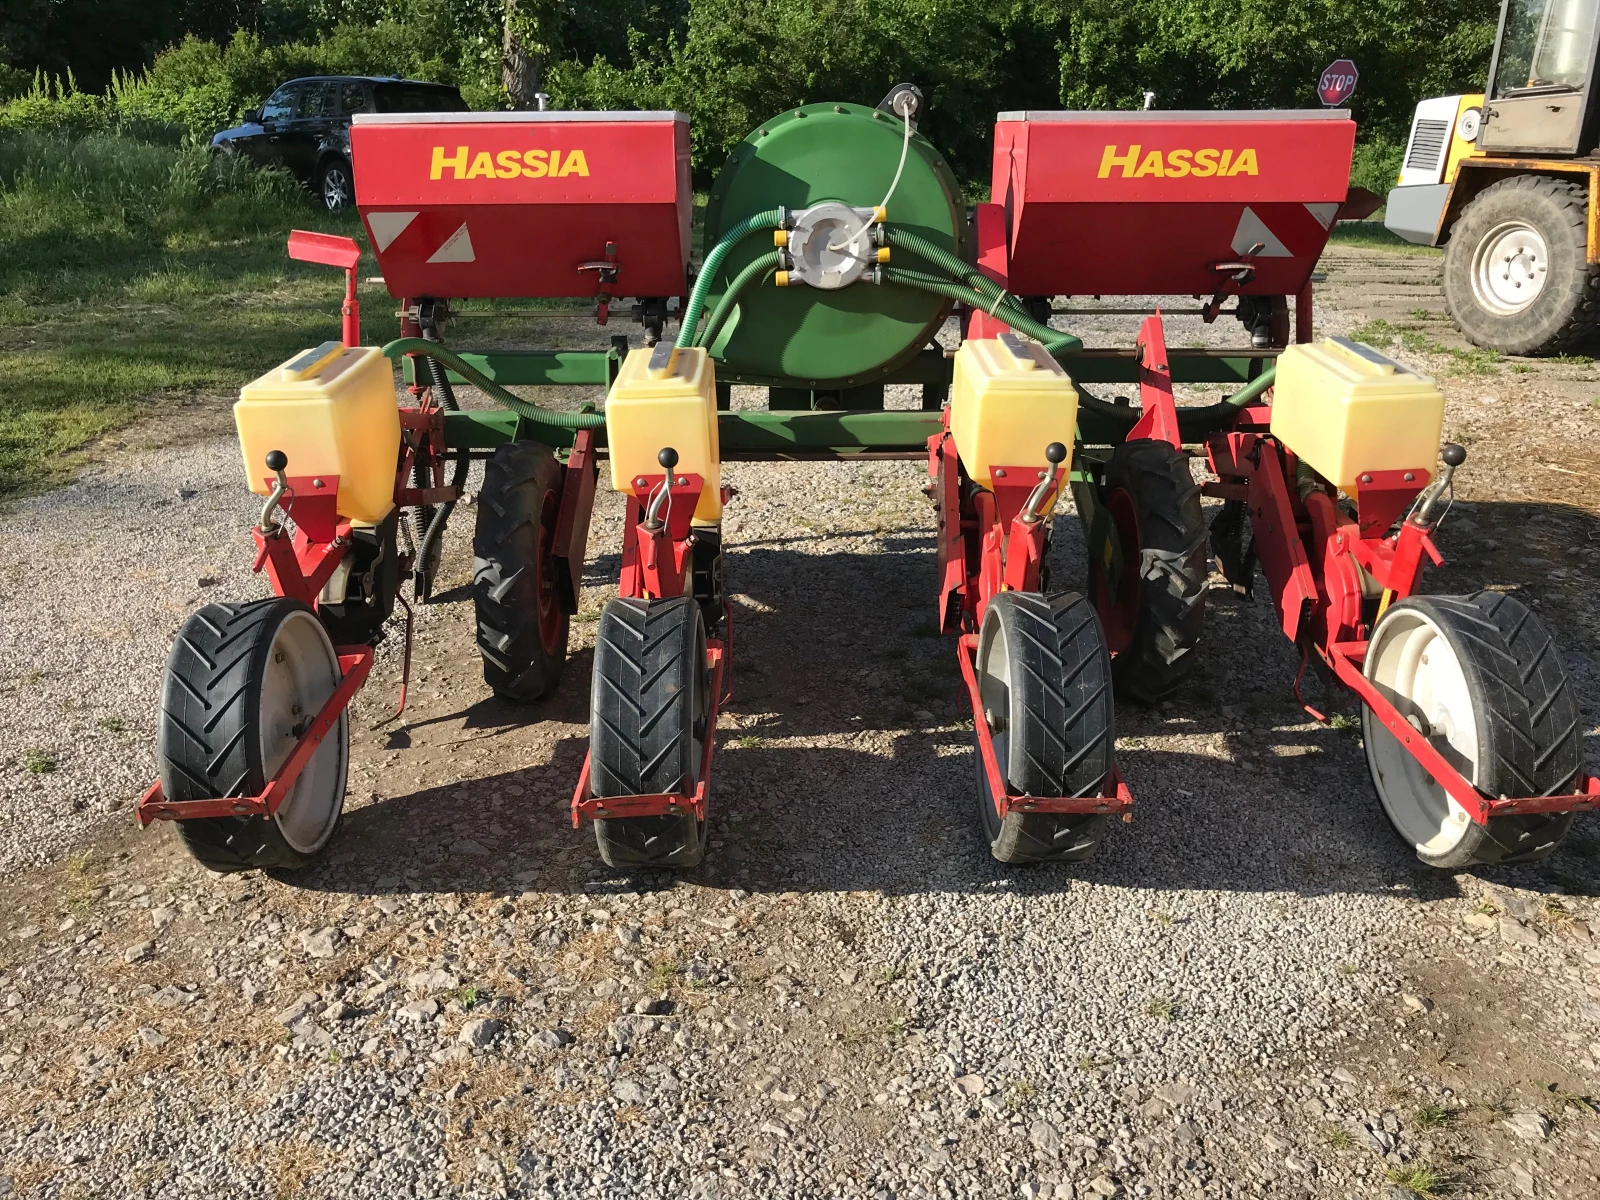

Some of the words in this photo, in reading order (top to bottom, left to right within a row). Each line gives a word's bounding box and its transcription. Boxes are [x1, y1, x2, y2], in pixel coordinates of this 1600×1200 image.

[1321, 74, 1354, 91] STOP
[430, 146, 590, 180] HASSIA
[1097, 145, 1259, 178] HASSIA
